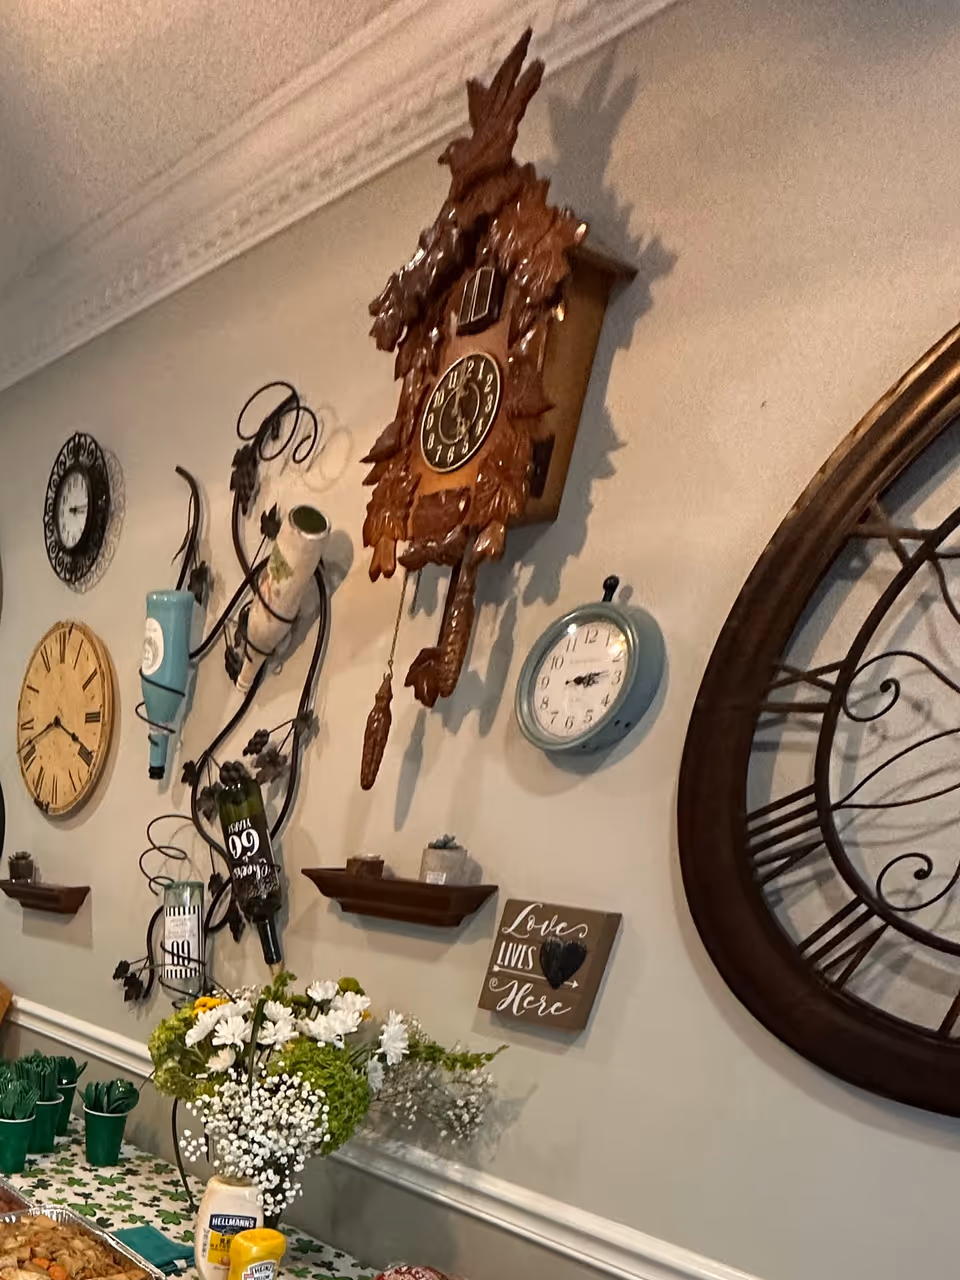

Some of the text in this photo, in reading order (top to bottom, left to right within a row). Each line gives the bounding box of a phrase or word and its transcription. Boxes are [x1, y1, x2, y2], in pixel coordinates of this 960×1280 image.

[477, 359, 486, 381] 1
[448, 371, 458, 389] 11
[484, 373, 493, 393] 2
[433, 388, 445, 409] 10
[485, 394, 494, 413] 3
[426, 412, 434, 430] 9
[427, 432, 435, 450] 8
[434, 444, 443, 463] 7
[447, 445, 456, 464] 6
[566, 637, 578, 652] 11
[584, 629, 599, 644] 12
[606, 629, 611, 647] 1
[550, 656, 564, 670] 10
[612, 650, 623, 663] 2
[540, 675, 550, 690] 9
[611, 670, 622, 686] 3
[540, 697, 549, 709] 8
[601, 693, 611, 707] 4
[550, 711, 559, 725] 7
[565, 715, 575, 730] 6
[583, 709, 593, 723] 5
[228, 828, 260, 859] 60
[501, 902, 589, 939] Love
[496, 941, 537, 970] LIVES
[488, 977, 572, 1017] Here
[212, 1216, 255, 1229] HELLMANN'S
